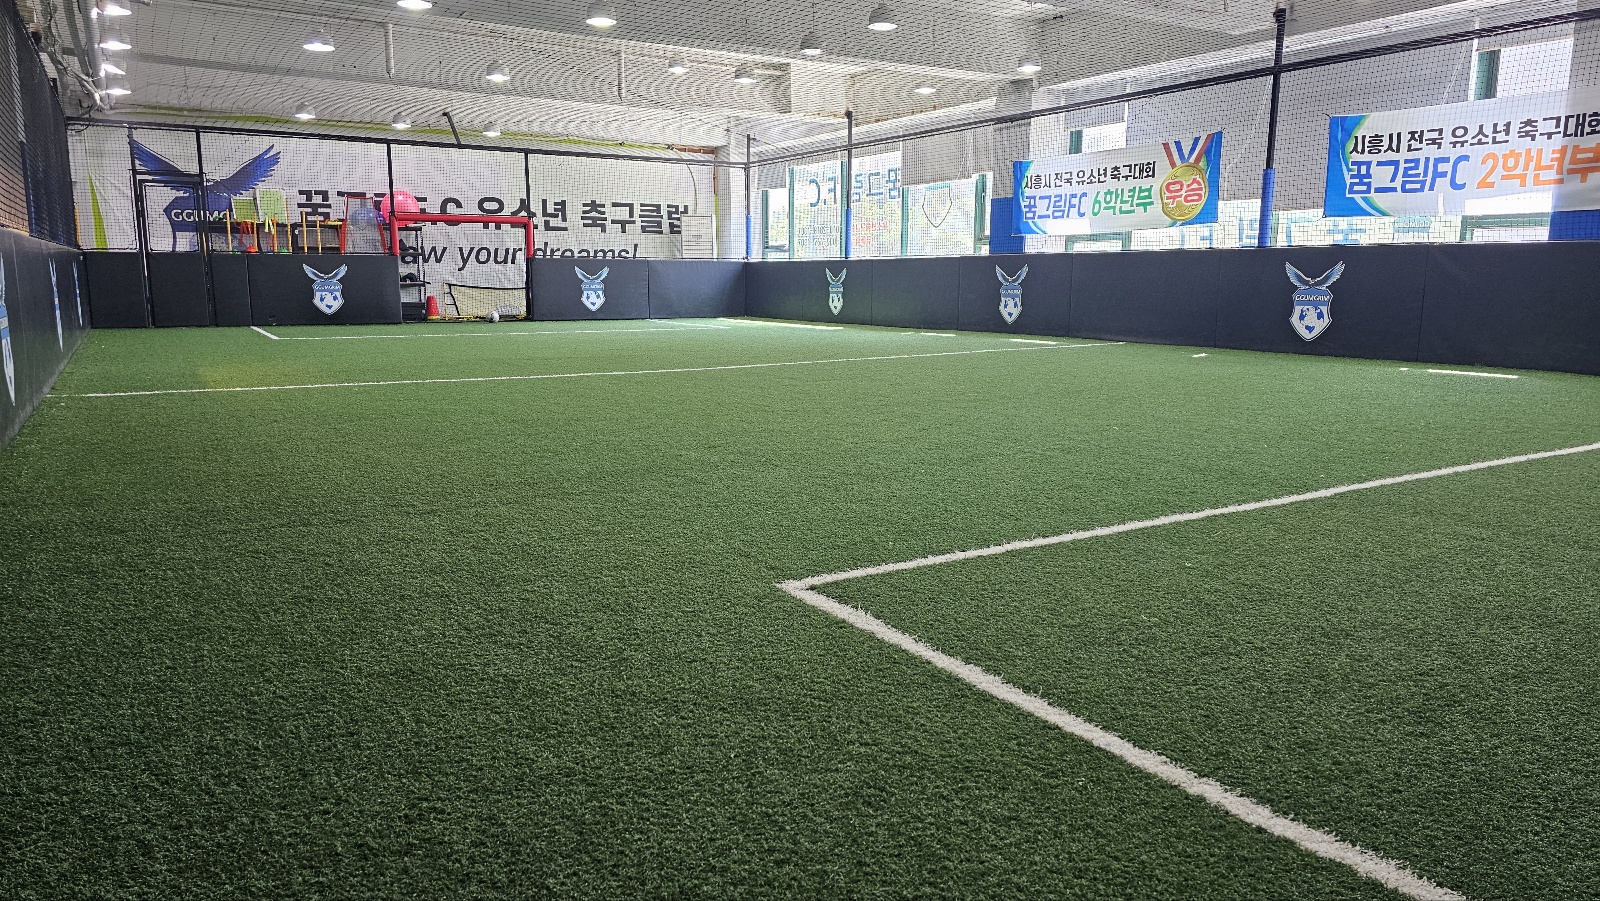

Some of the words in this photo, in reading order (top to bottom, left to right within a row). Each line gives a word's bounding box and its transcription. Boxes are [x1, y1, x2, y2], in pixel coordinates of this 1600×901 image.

[1349, 131, 1402, 155] 시흥시
[1407, 127, 1444, 152] 전국
[1449, 120, 1512, 150] 유소년
[1517, 111, 1600, 142] 축구대회
[1024, 173, 1052, 190] 시흥시
[1054, 171, 1073, 188] 전국
[1076, 166, 1108, 185] 유소년
[1110, 160, 1156, 182] 축구대회
[1347, 154, 1471, 195] 꿈그림FC
[1476, 142, 1600, 190] 2학년부
[1023, 191, 1088, 221] 꿈그림FC
[1091, 185, 1155, 217] 6학년부
[1164, 177, 1205, 206] 우승
[477, 196, 569, 232] 유소년
[580, 199, 689, 235] 축구클럽
[458, 246, 523, 271] your
